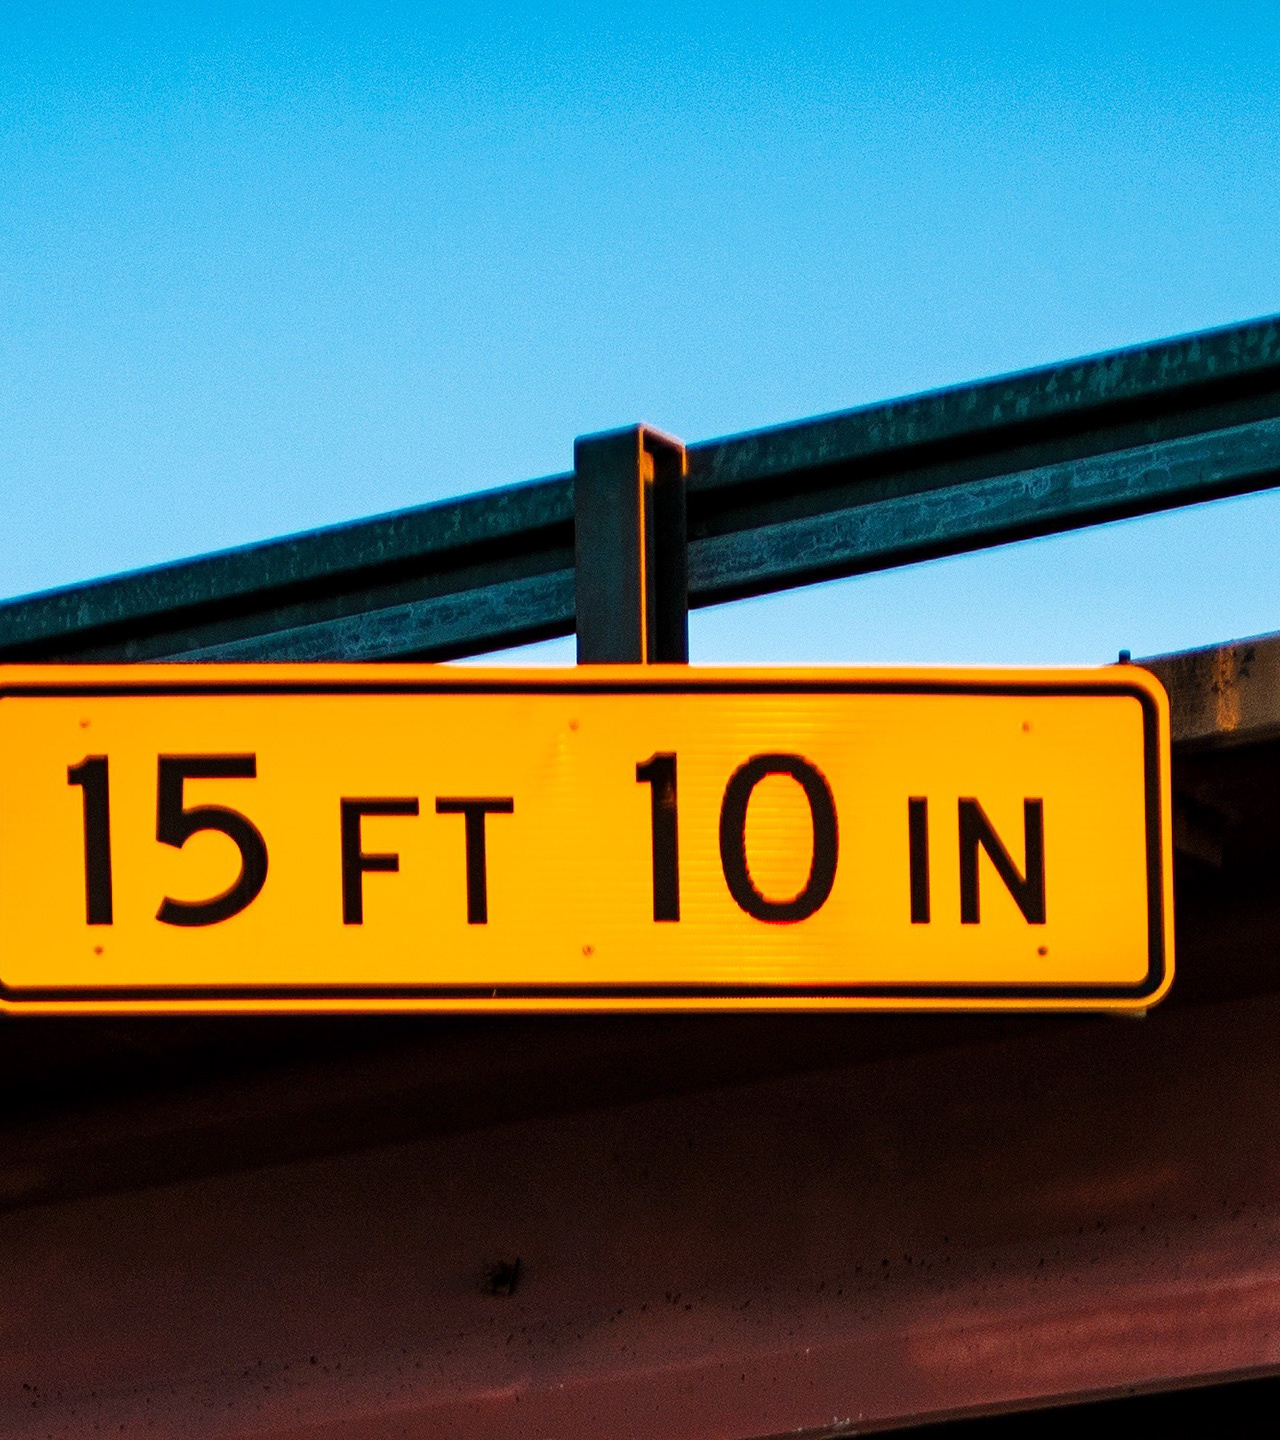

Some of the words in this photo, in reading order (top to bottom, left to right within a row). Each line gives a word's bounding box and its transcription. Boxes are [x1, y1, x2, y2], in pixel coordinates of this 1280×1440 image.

[66, 752, 269, 928] 15
[339, 796, 515, 925] FT
[635, 751, 840, 925] 10
[907, 795, 1047, 925] IN
